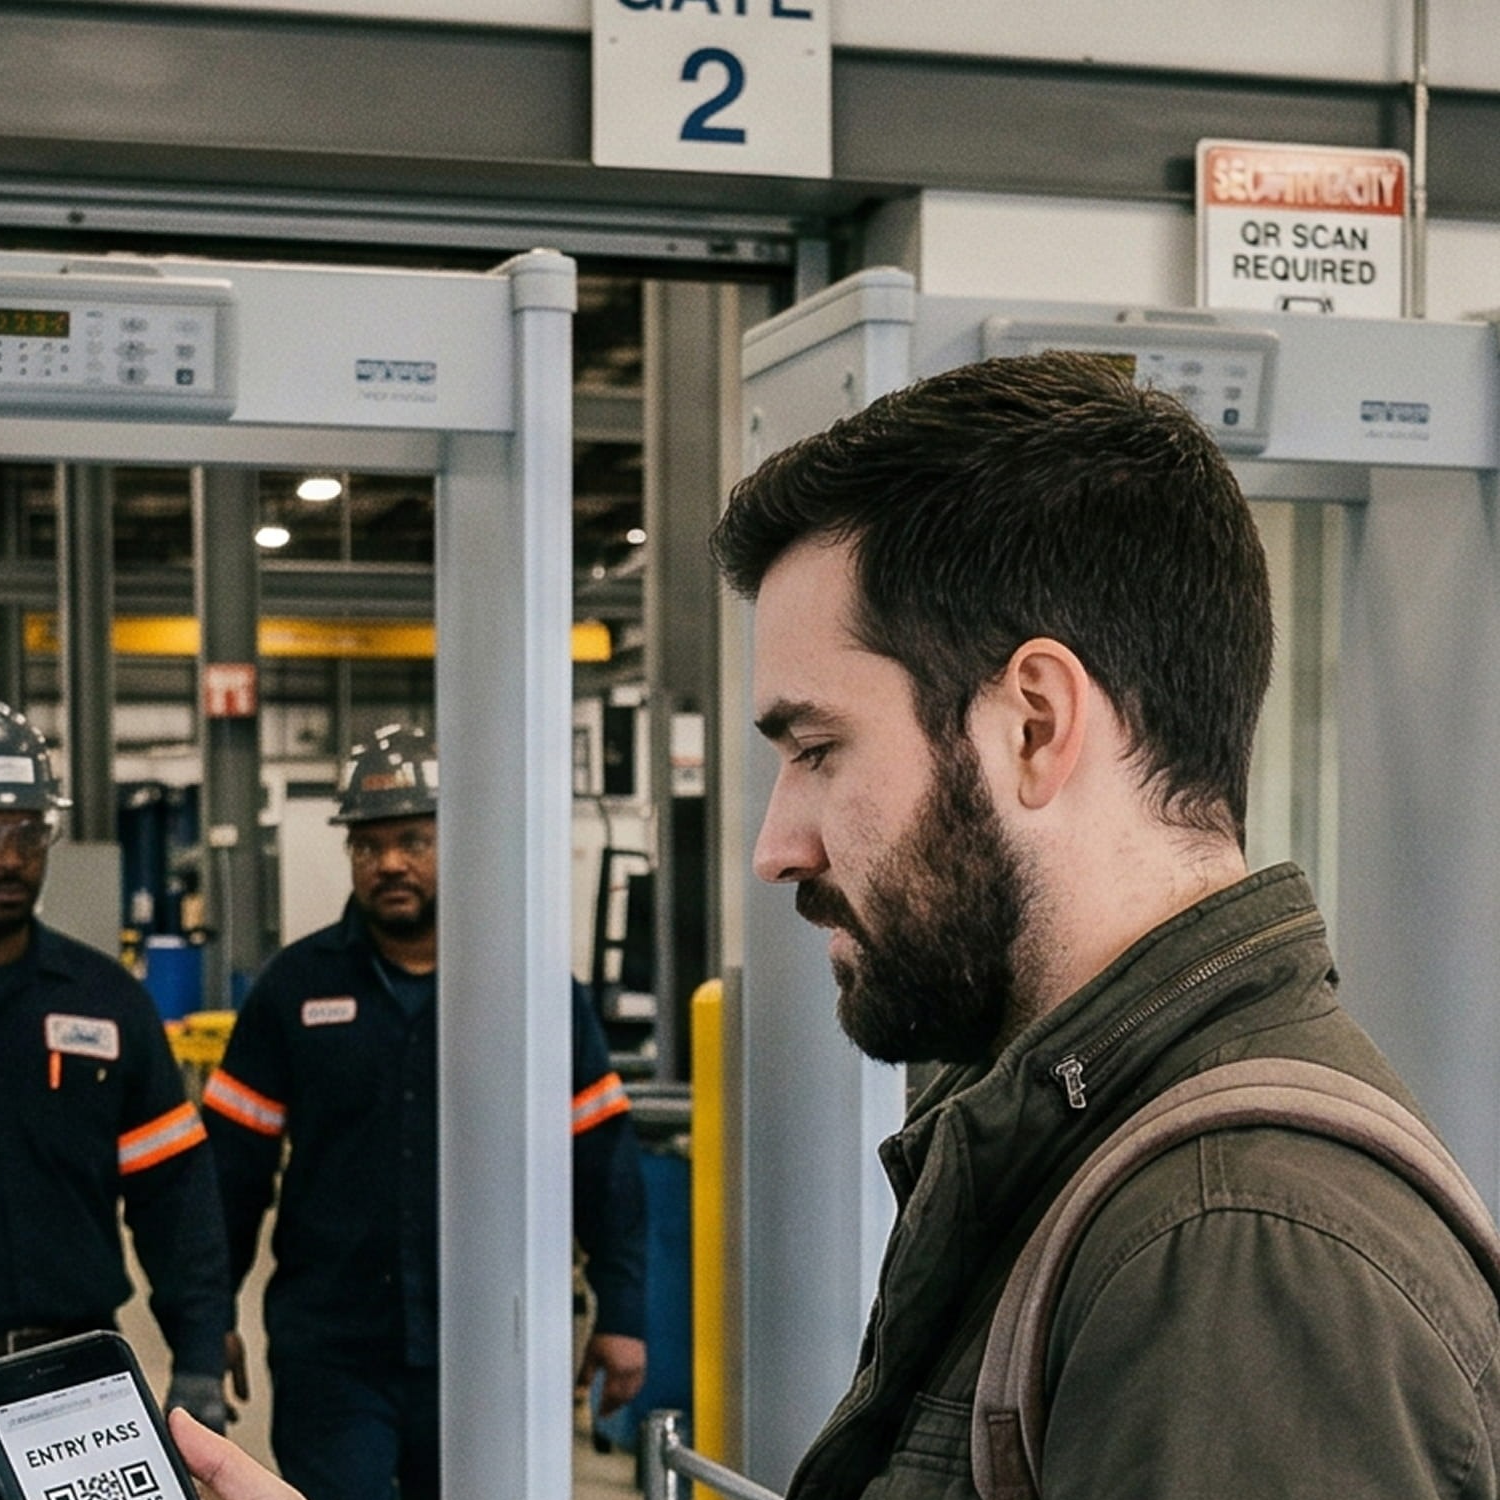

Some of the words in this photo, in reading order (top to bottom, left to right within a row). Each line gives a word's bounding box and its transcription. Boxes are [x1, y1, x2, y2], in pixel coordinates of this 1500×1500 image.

[680, 47, 745, 144] 2
[1241, 220, 1281, 247] QR
[1292, 223, 1369, 250] SCAN
[1233, 254, 1377, 285] REQUIRED
[25, 1435, 88, 1468] ENTRY
[92, 1420, 141, 1448] PASS
